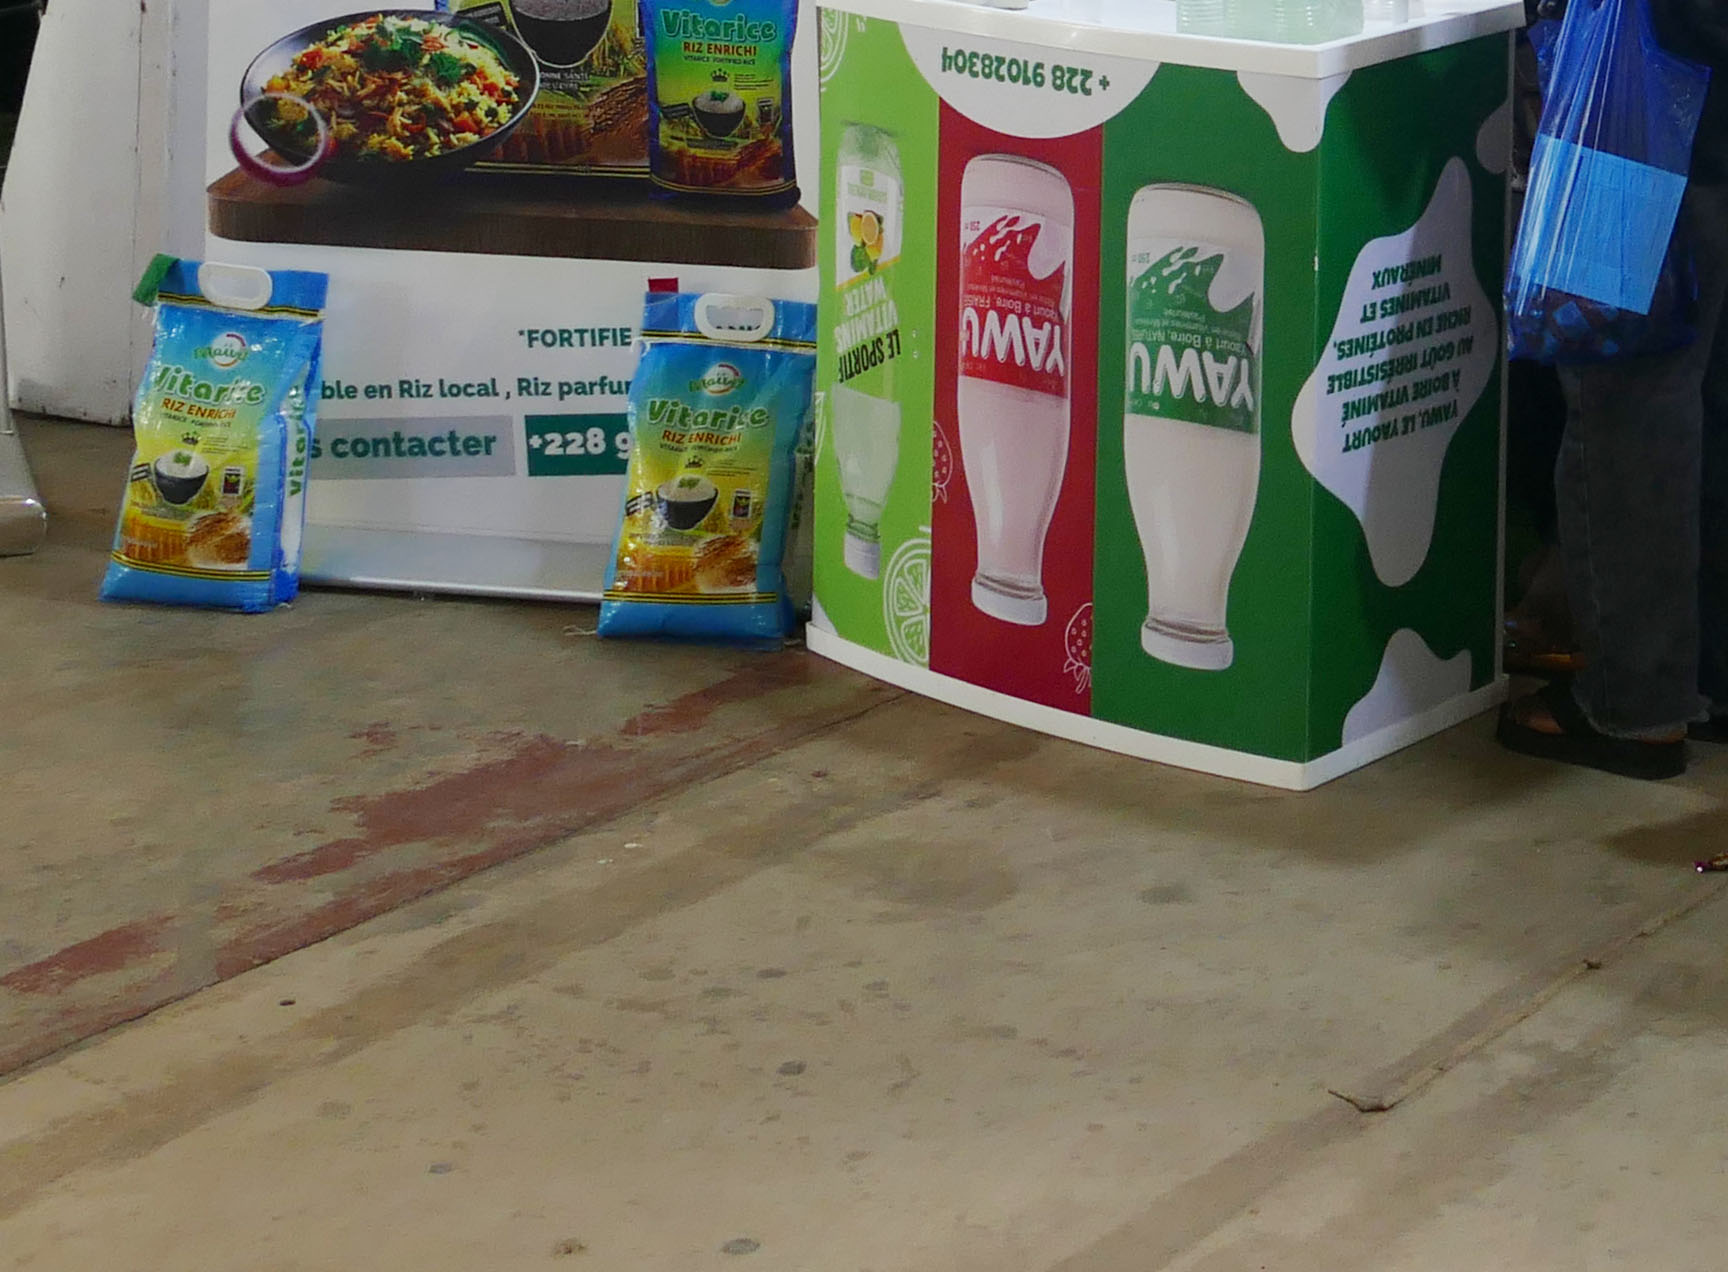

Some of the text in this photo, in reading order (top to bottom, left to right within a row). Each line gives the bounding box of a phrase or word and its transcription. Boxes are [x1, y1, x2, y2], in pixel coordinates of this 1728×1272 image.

[660, 8, 778, 42] Vitarice
[683, 41, 757, 56] RIZ ENRICHI
[941, 45, 1045, 89] 91028304
[1051, 63, 1093, 97] 228
[1371, 253, 1443, 291] MINÉRAUX
[1360, 281, 1451, 324] VITAMINES ET
[962, 306, 1065, 377] YAWU
[1333, 321, 1415, 360] PROTÉINES,
[1415, 316, 1432, 339] EN
[838, 328, 901, 384] LE SPORTIF
[1420, 341, 1456, 371] GOÛT
[364, 383, 393, 400] en
[399, 377, 433, 399] Riz
[439, 377, 499, 398] local
[517, 376, 552, 397] Riz
[558, 375, 630, 402] parfu
[1129, 341, 1255, 412] YAWU
[1326, 353, 1418, 396] IRRÉSISTIBLE
[1413, 374, 1450, 401] BOIRE
[162, 397, 236, 419] RIZ ENRICHI
[1341, 384, 1410, 428] VITAMINÉ
[528, 427, 606, 456] +228
[661, 429, 742, 446] RIZ ENRICHI
[1342, 419, 1399, 454] YAOURT
[1402, 414, 1416, 435] LE
[330, 430, 497, 459] contacter
